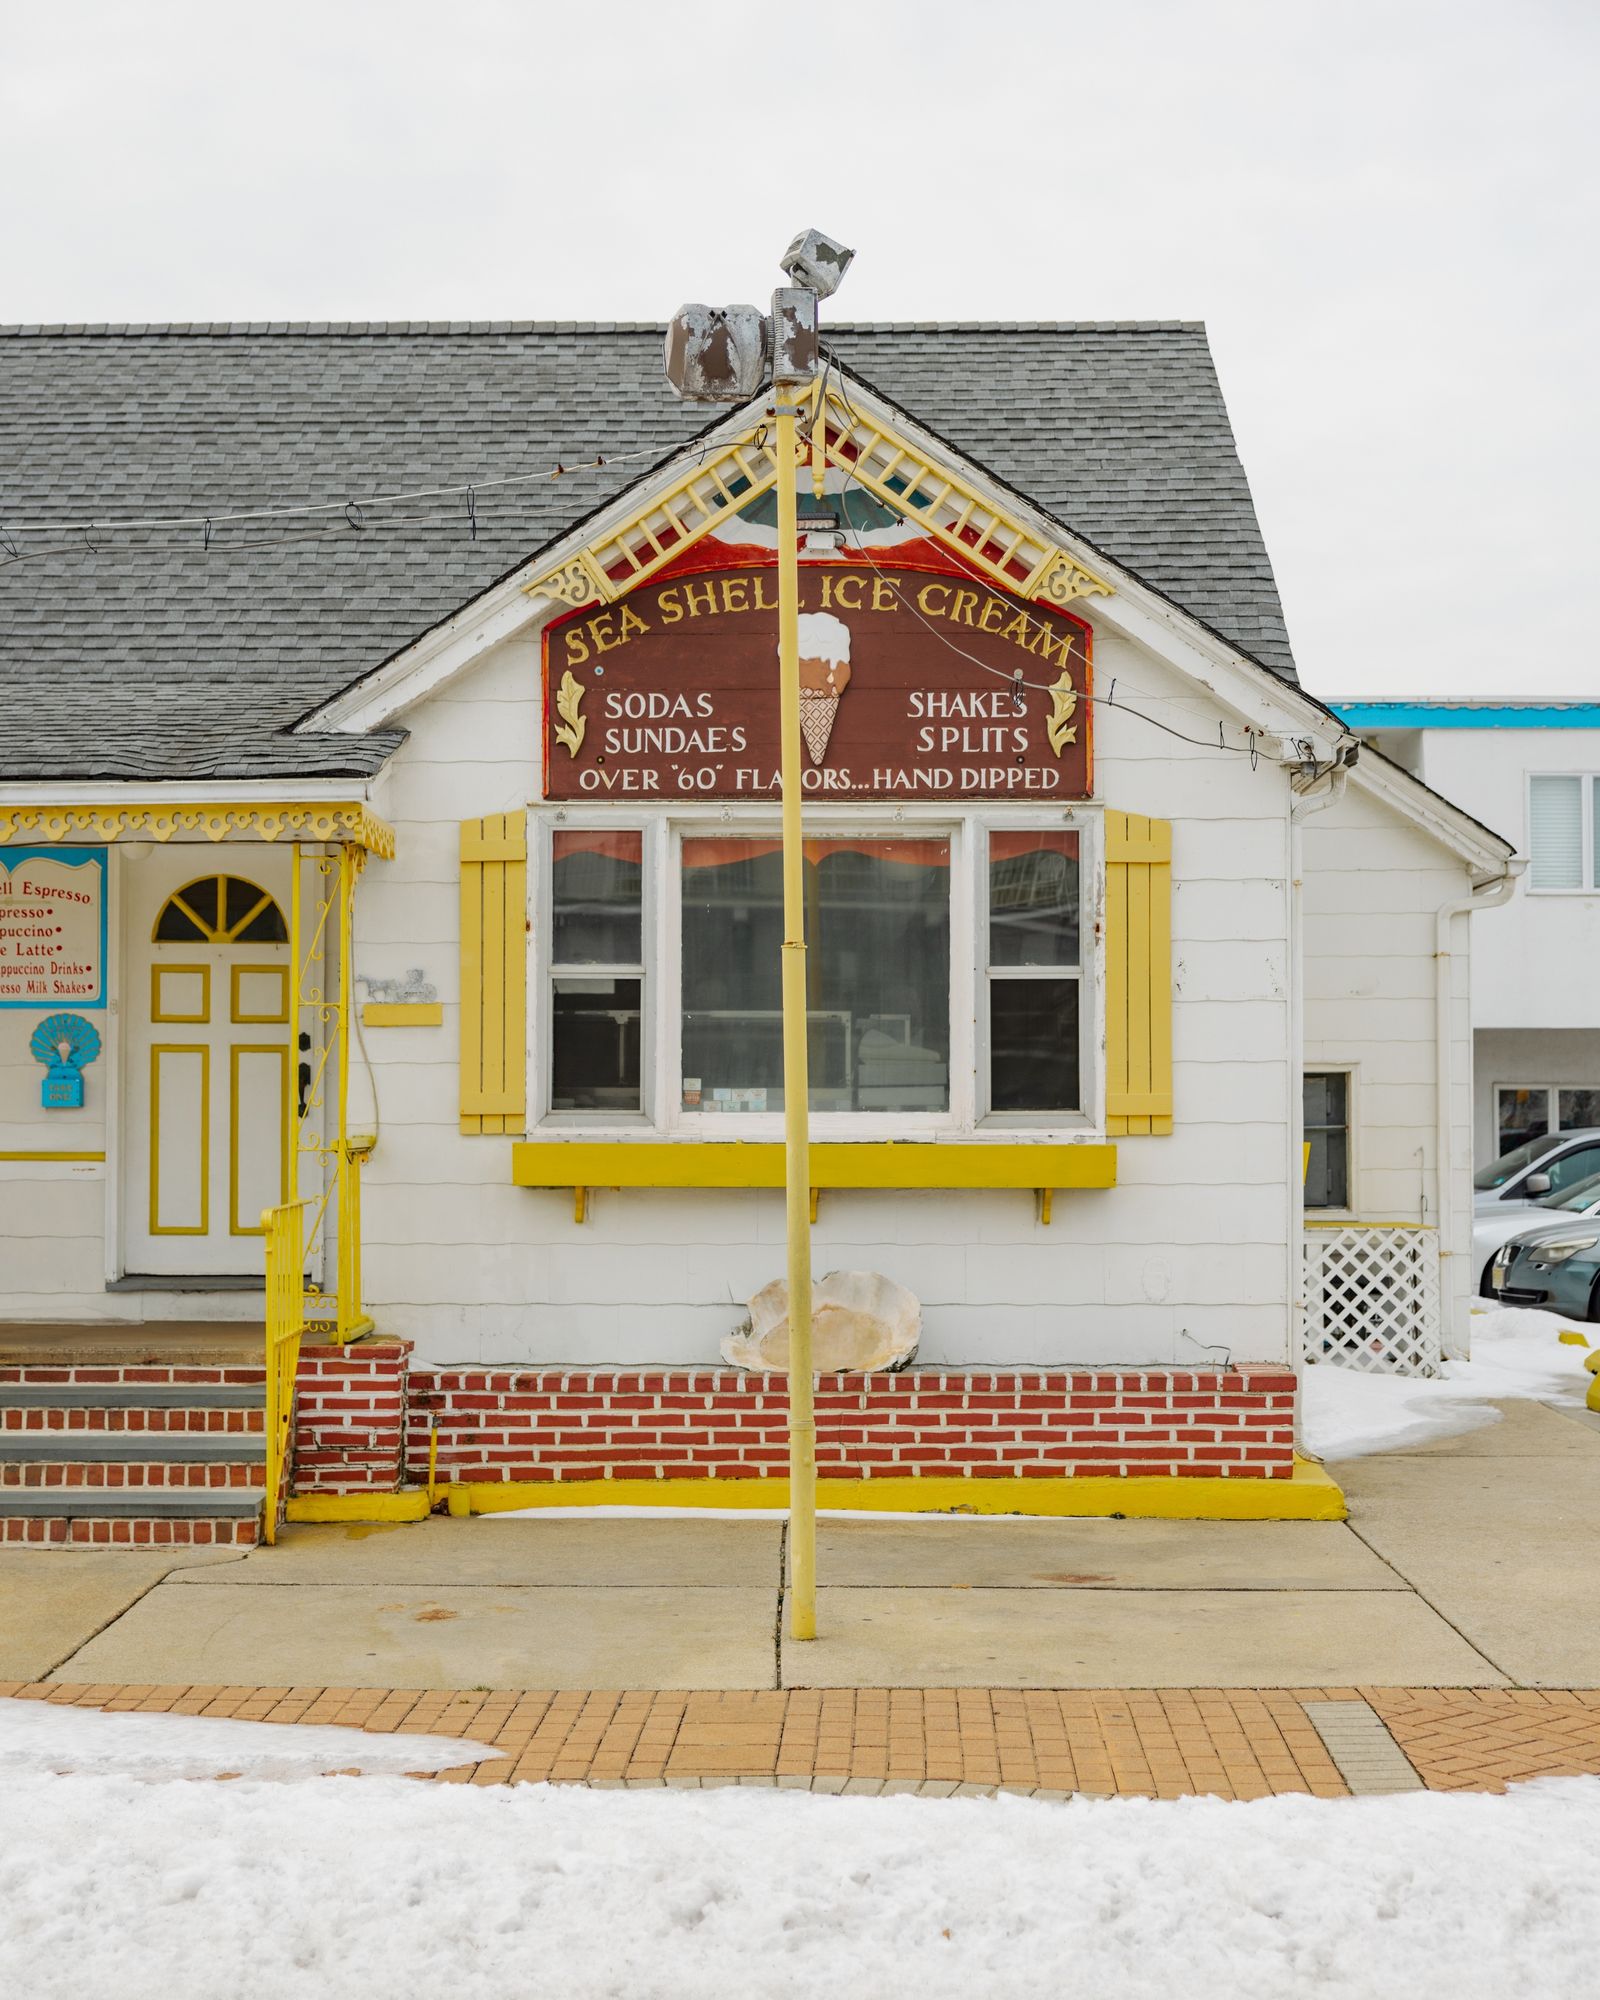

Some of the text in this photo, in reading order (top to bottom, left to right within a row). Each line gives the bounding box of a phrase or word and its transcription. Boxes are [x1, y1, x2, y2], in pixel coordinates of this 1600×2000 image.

[564, 575, 1075, 669] SEA SHEL ICE CREAM
[604, 693, 714, 719] SODAS
[907, 692, 1028, 719] SHAKES
[604, 727, 747, 754] SUNDAES
[916, 726, 1029, 753] SPLITS
[579, 769, 660, 791] OVER
[960, 768, 1060, 790] DIPPED
[23, 881, 91, 904] Espresso
[16, 943, 54, 956] Latte
[50, 961, 84, 975] Drinks
[26, 980, 48, 994] Milk
[53, 980, 87, 994] Shakes
